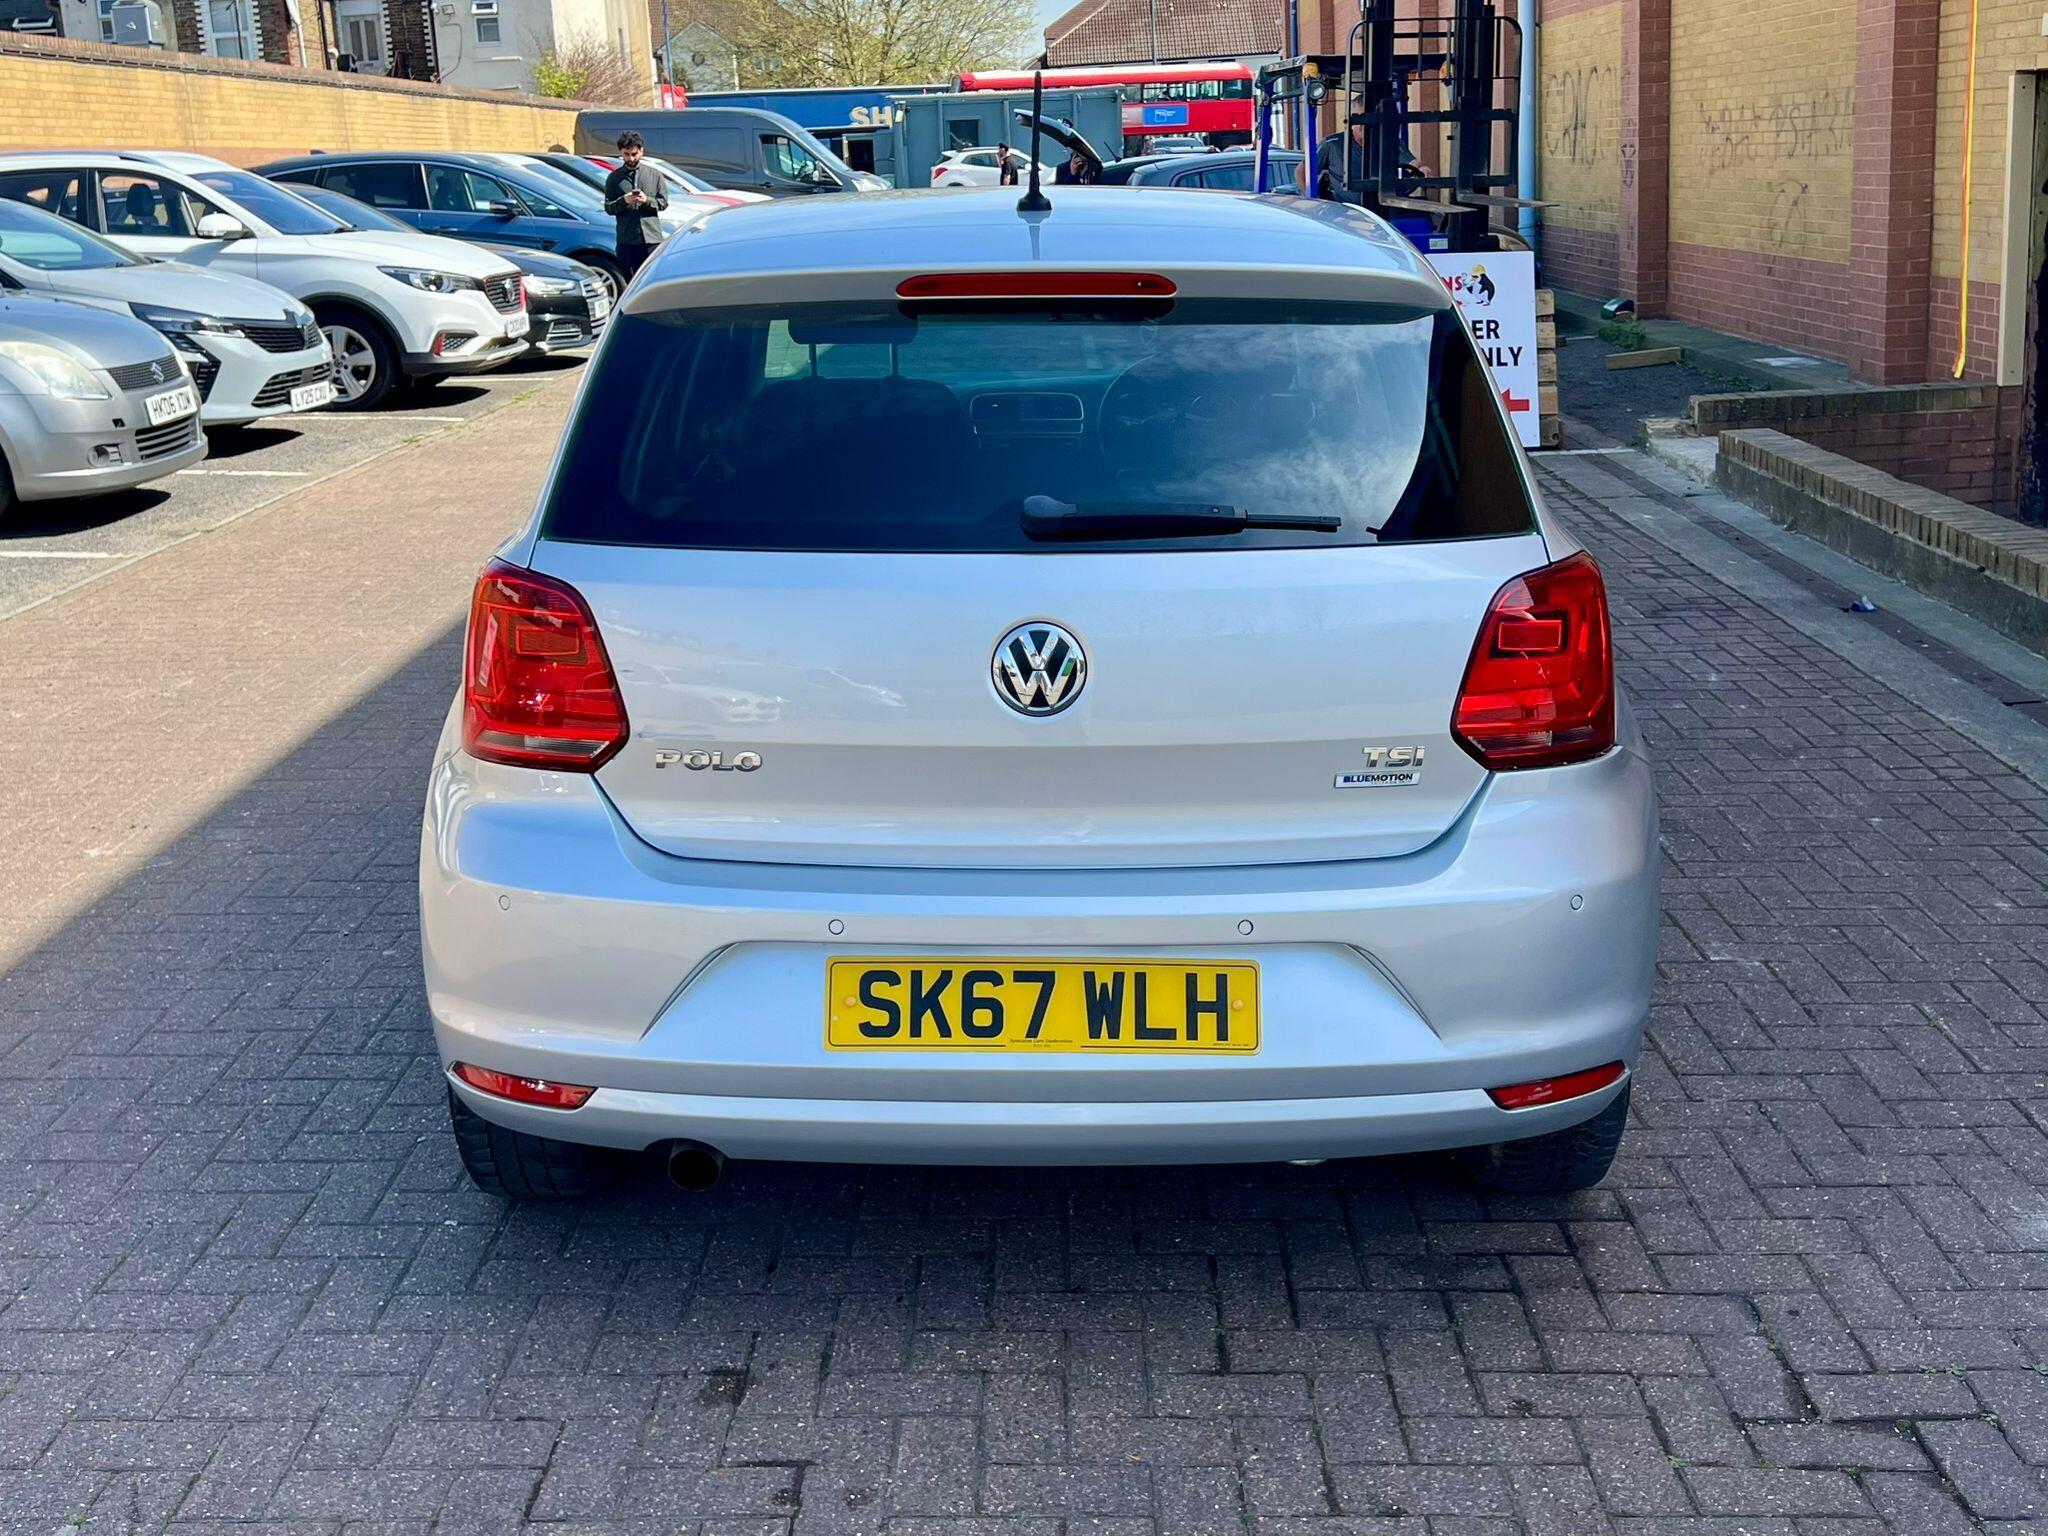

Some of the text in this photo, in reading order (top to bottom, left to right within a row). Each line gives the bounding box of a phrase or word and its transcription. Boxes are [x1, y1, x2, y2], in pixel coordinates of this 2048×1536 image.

[850, 106, 892, 127] SH
[1472, 319, 1500, 339] ER
[1481, 346, 1523, 367] NLY
[655, 747, 763, 772] POLO
[1343, 773, 1414, 783] BLUEMOTION
[857, 969, 1229, 1042] SK67 WLH
